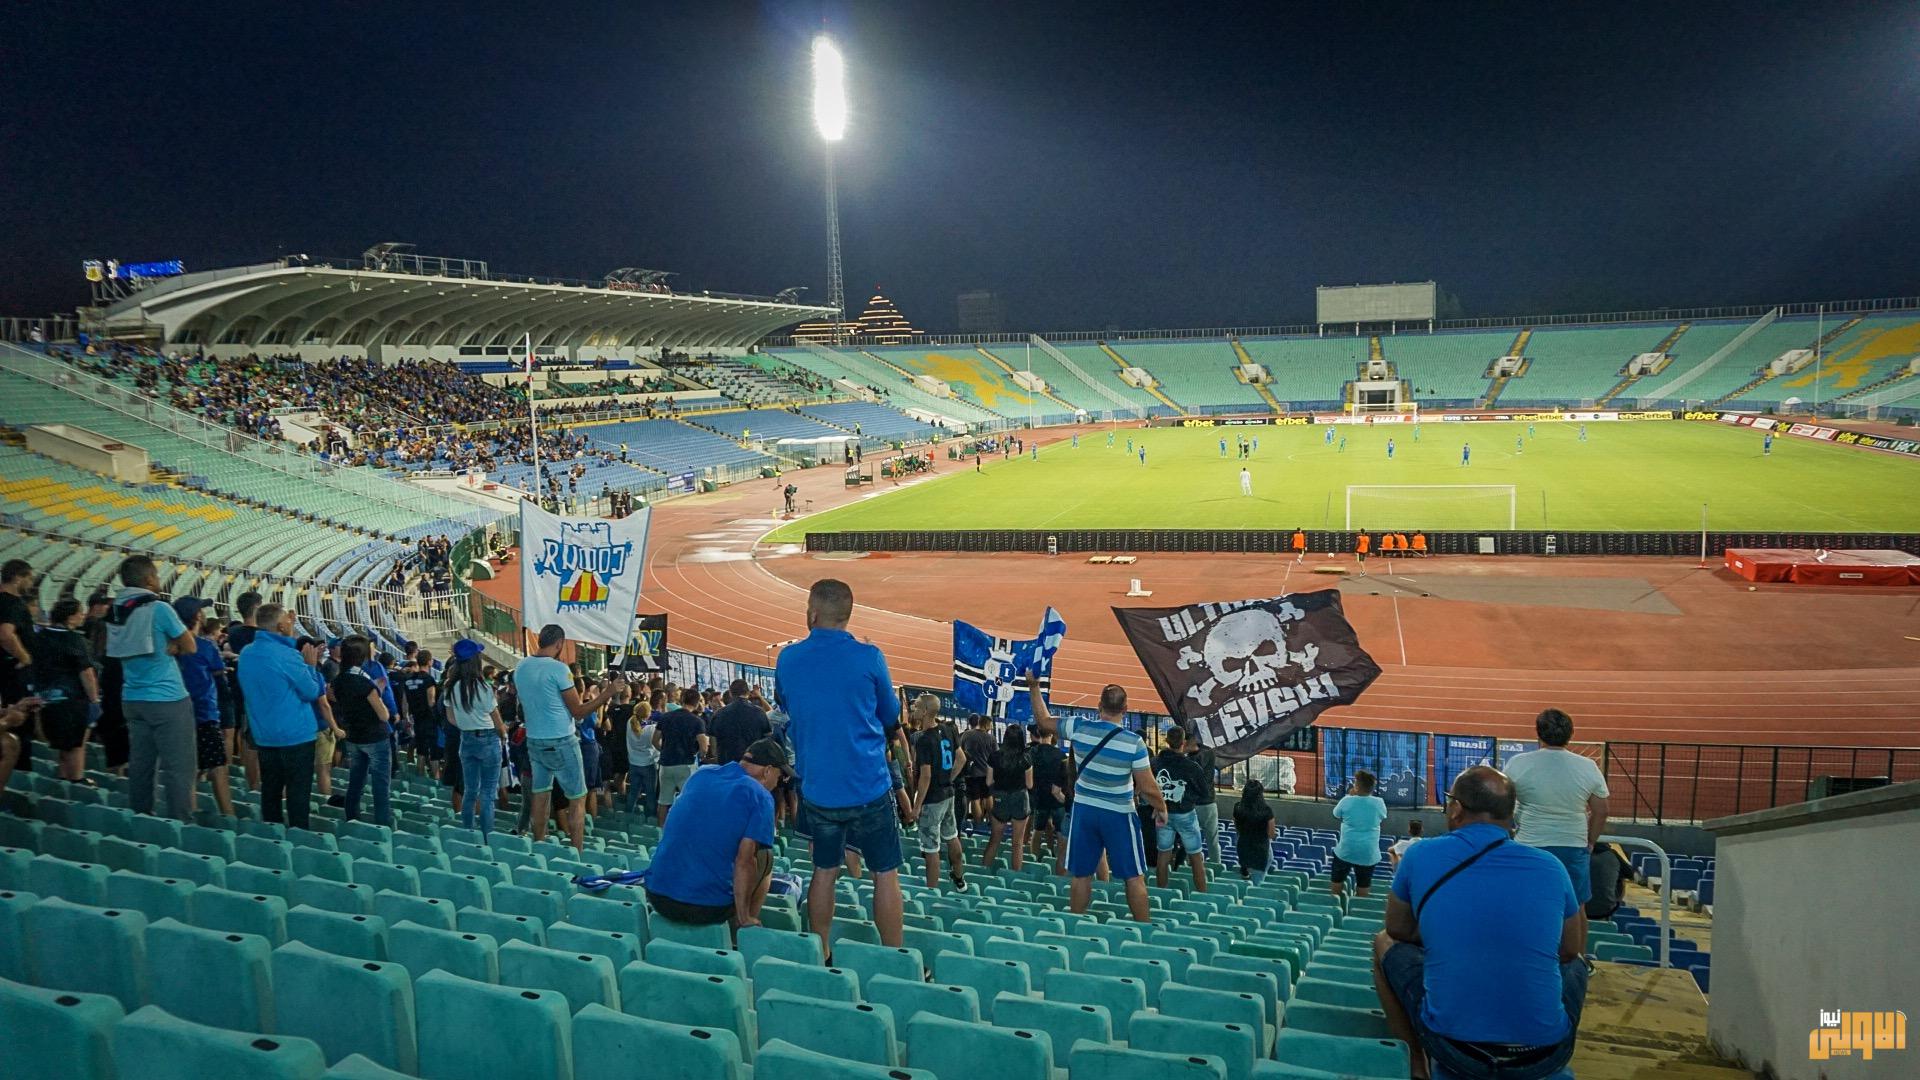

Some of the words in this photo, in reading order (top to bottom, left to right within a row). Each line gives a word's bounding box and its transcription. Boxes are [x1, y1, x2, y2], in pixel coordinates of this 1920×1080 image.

[1646, 412, 1672, 420] efbet
[1684, 412, 1719, 421] efbet
[1183, 419, 1215, 428] efbet
[1275, 417, 1308, 426] efbet
[940, 739, 953, 770] 6
